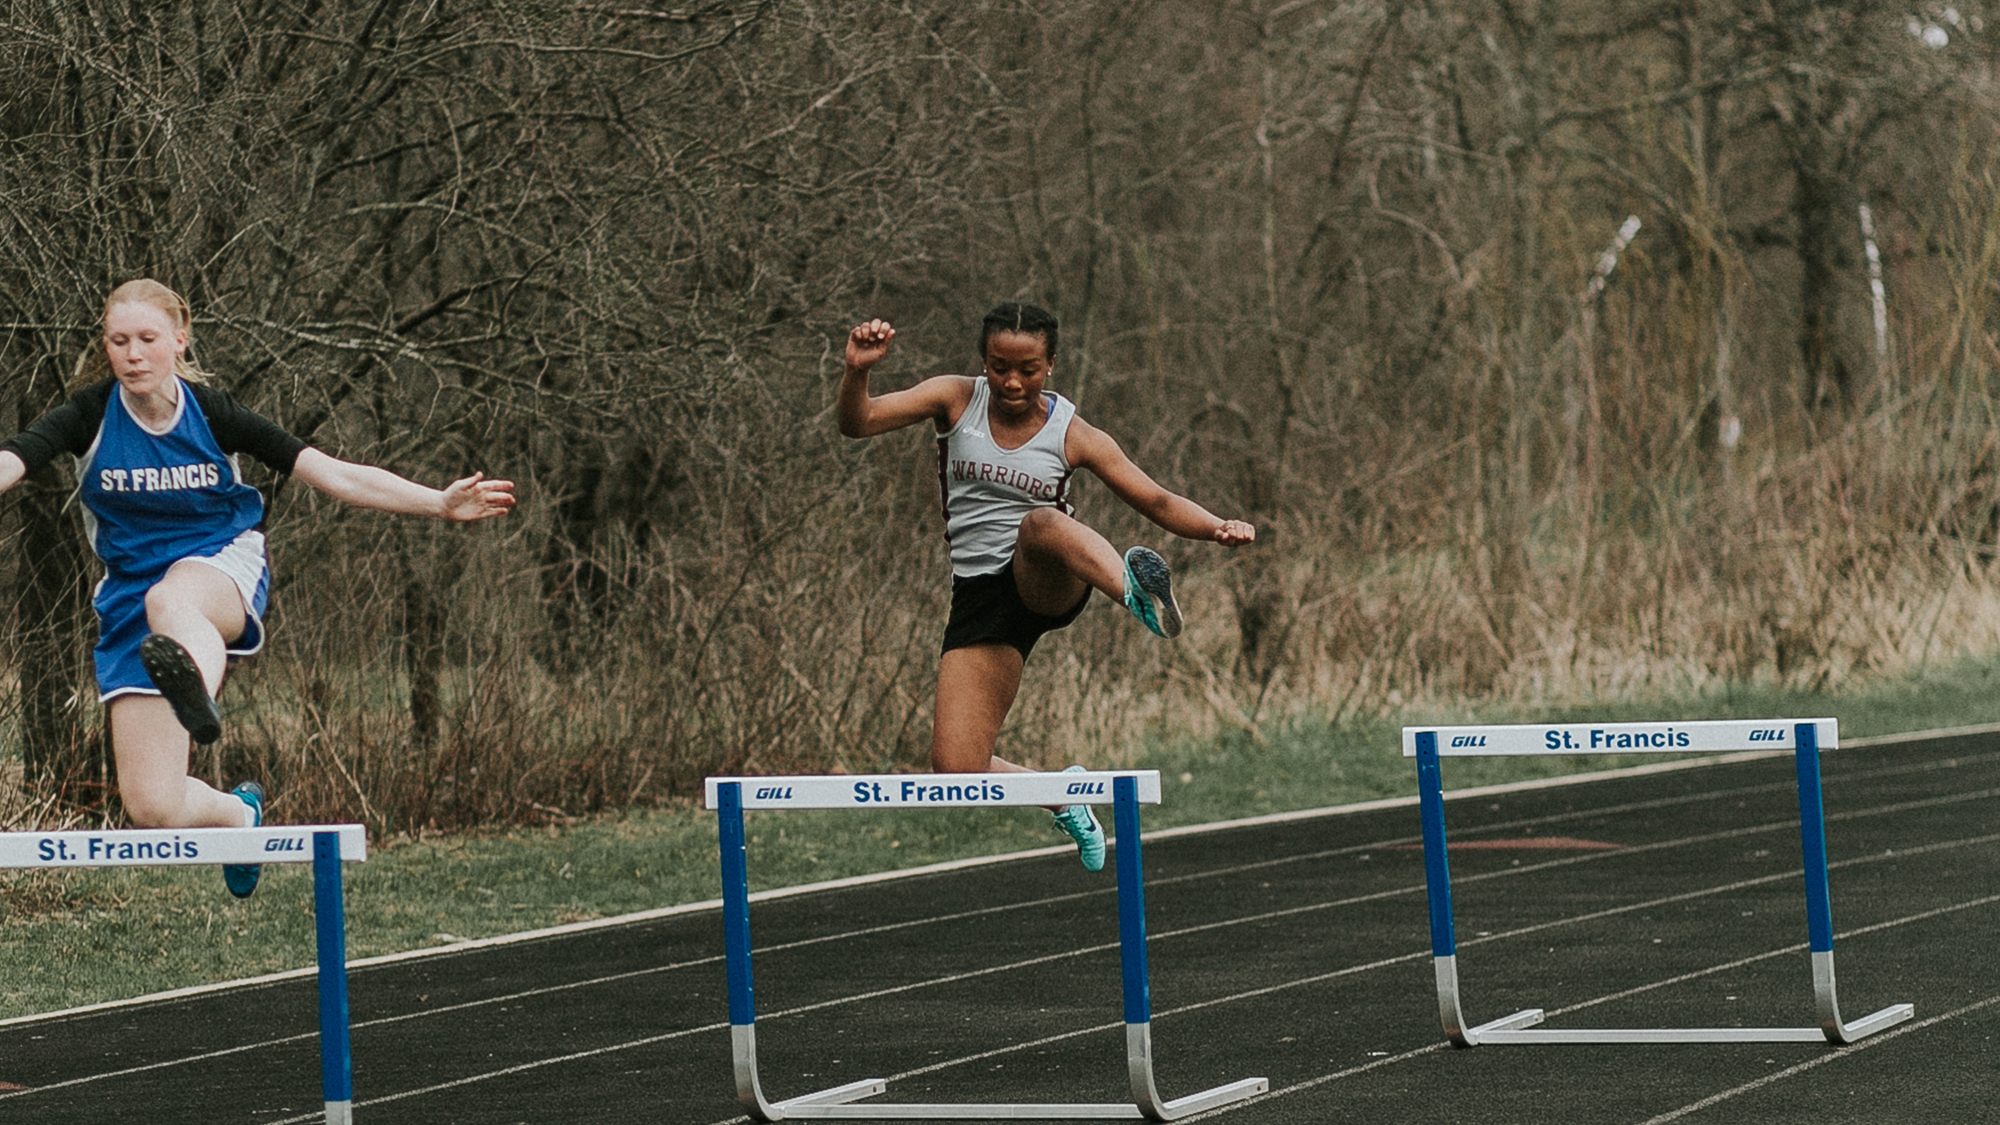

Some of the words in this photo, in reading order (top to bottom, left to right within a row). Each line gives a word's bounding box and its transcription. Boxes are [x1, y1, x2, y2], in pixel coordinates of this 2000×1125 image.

[1451, 735, 1487, 748] GILL
[1545, 730, 1579, 750] St.
[1590, 728, 1690, 749] Francis
[1749, 729, 1785, 742] GILL
[756, 786, 793, 799] GILL
[854, 781, 890, 803] St.
[901, 779, 1005, 801] Francis
[1066, 782, 1104, 795] GILL
[39, 838, 75, 861] St.
[89, 836, 199, 859] Francis
[265, 838, 304, 852] GILL
